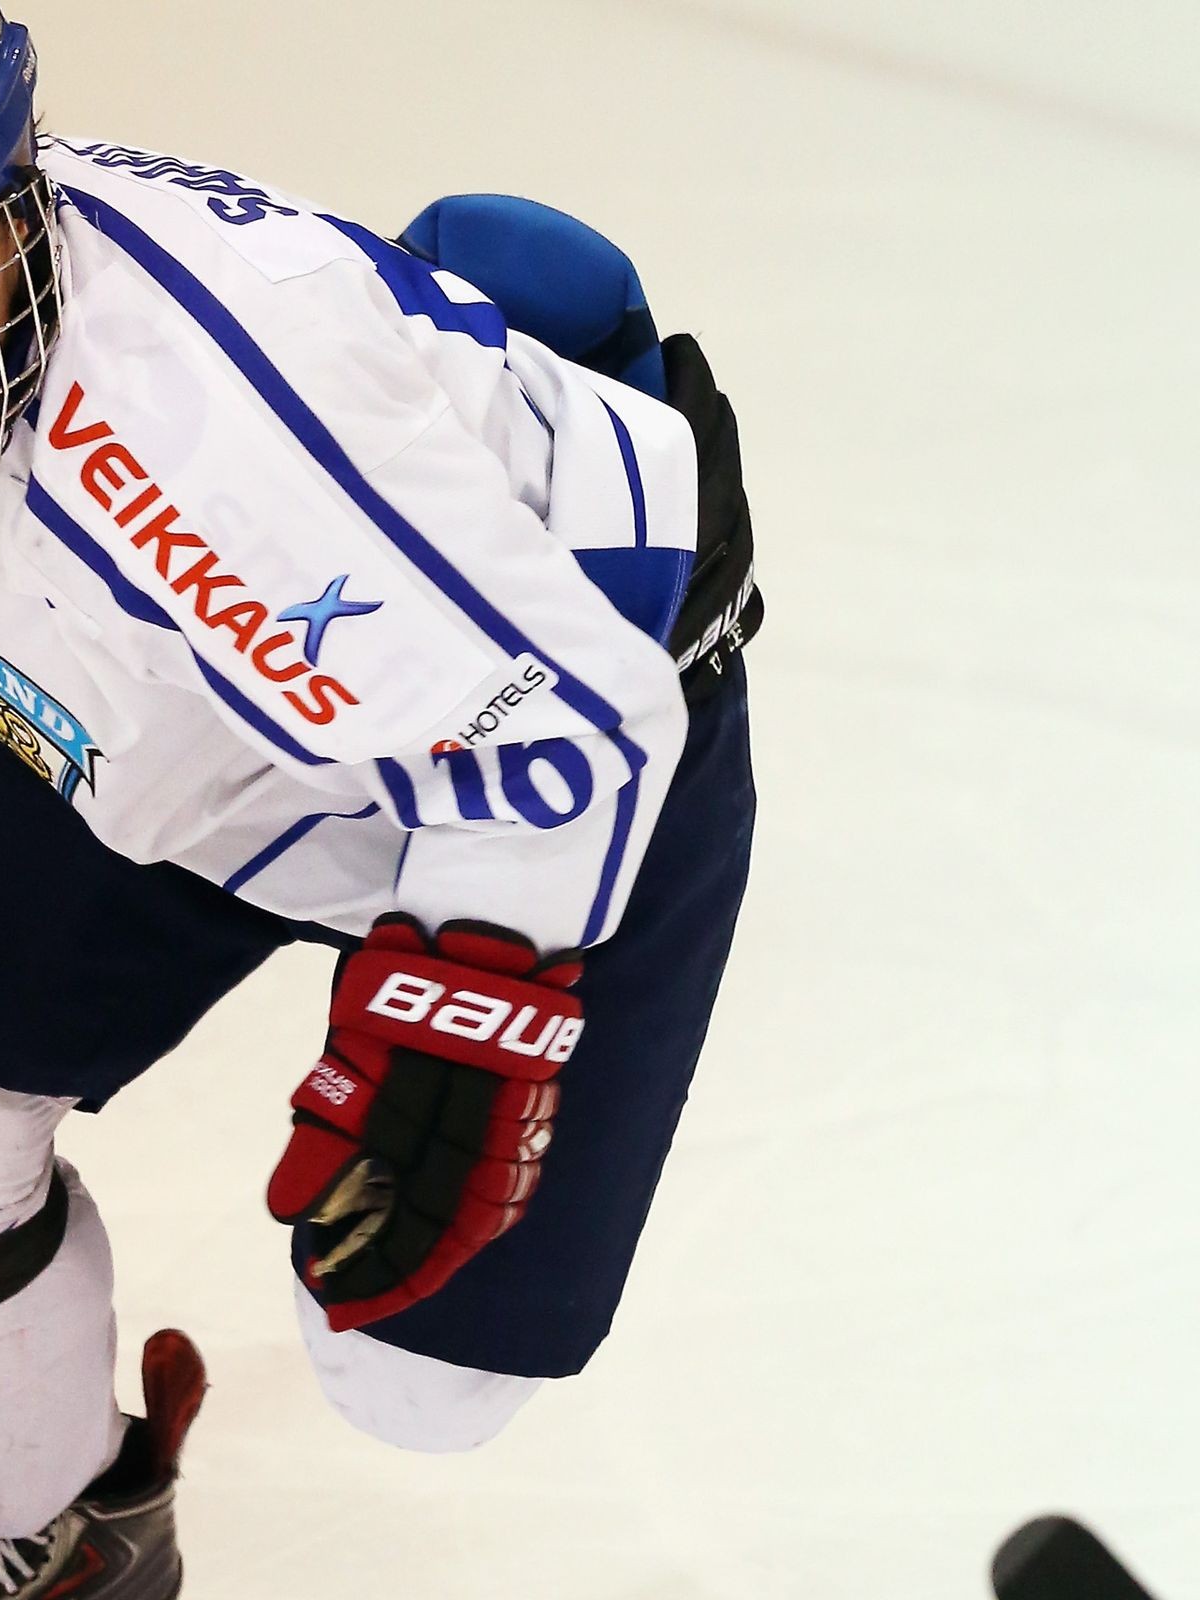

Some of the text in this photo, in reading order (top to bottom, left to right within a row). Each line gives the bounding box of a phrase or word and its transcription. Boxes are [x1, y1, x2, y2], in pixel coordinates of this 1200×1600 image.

[48, 380, 361, 726] VEIKKAUS
[458, 664, 546, 746] HOTELS
[431, 736, 593, 829] 16
